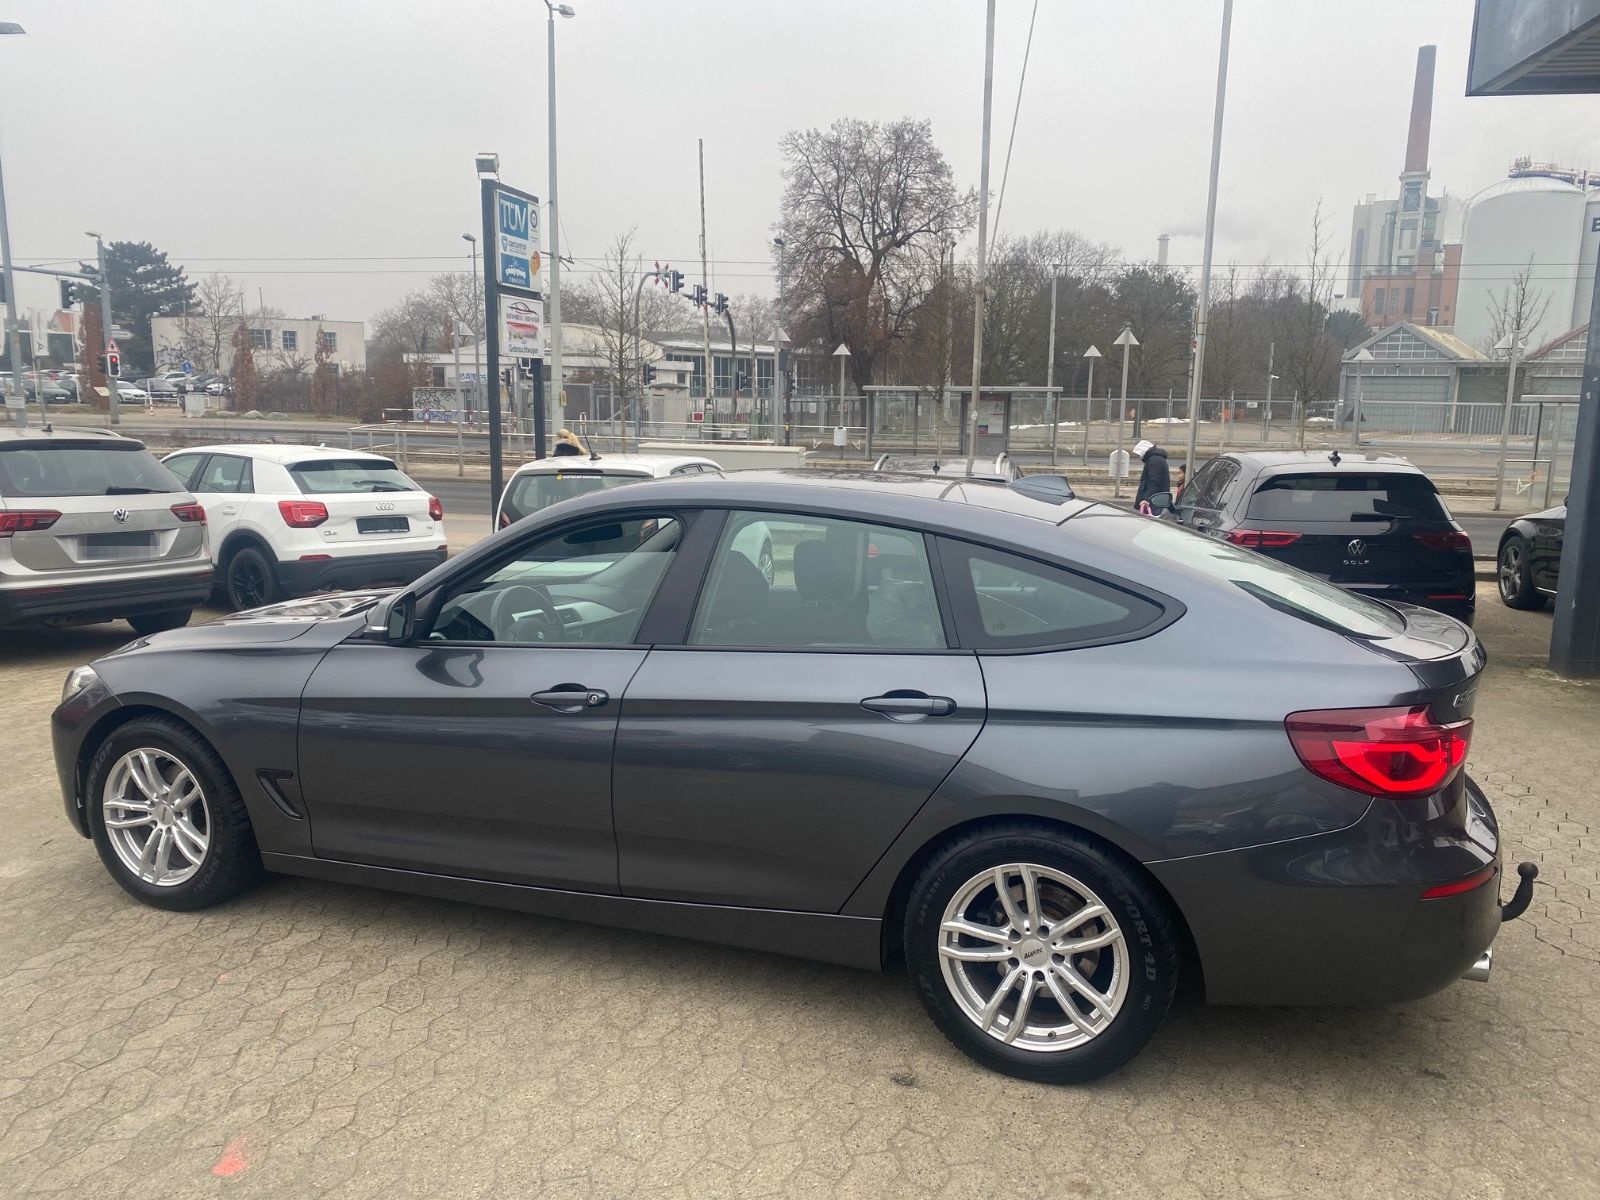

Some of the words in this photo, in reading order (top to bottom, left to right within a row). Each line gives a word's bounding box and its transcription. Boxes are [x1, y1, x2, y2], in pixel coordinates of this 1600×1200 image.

[500, 199, 527, 233] TÜV
[509, 344, 539, 356] Gebrauchtwagen
[1112, 882, 1153, 948] SPORT
[1143, 950, 1158, 982] 4D
